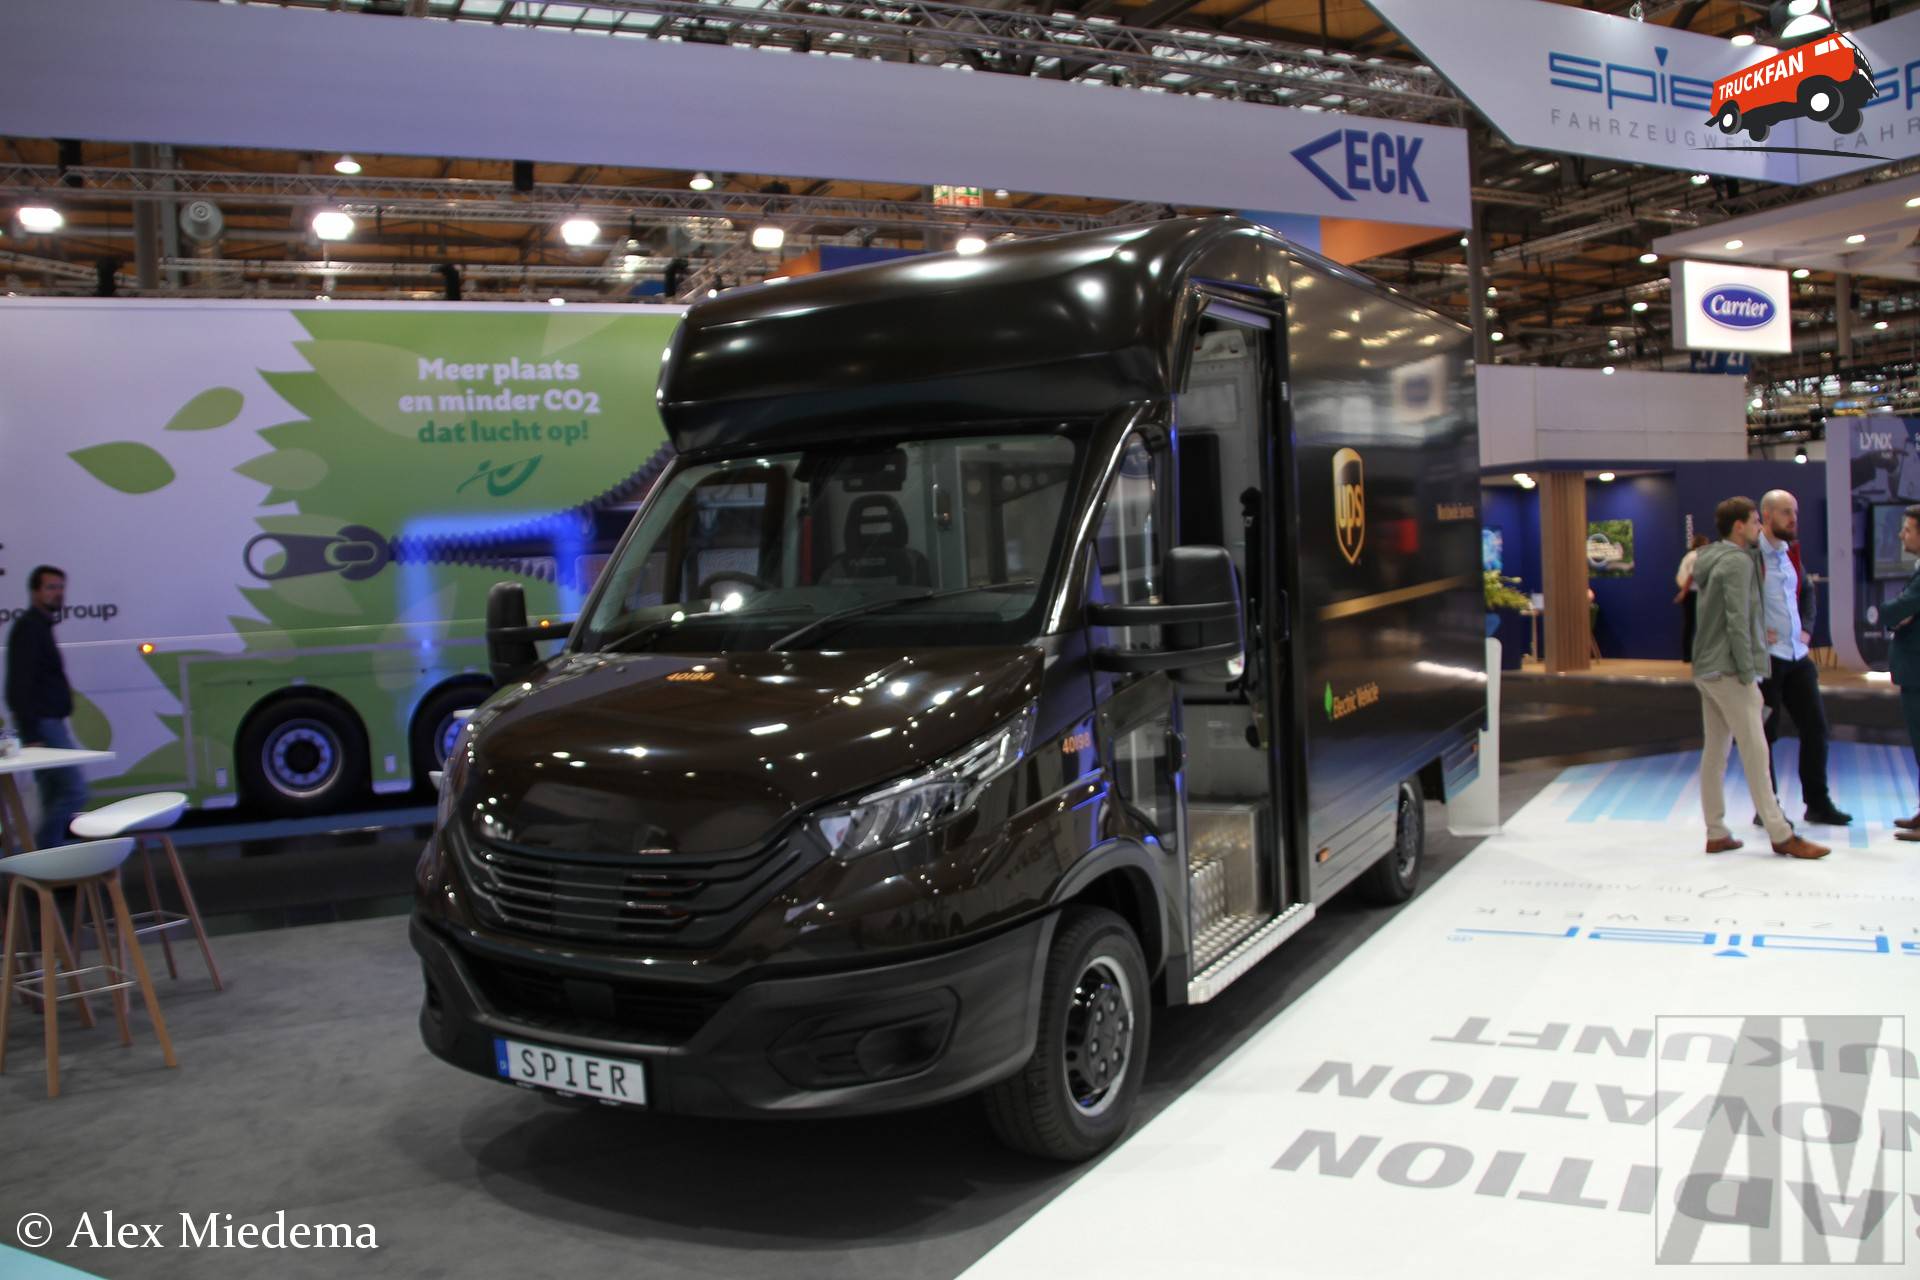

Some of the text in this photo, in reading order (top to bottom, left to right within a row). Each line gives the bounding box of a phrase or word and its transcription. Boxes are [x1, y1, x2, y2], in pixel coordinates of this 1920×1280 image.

[1550, 46, 1714, 112] spie
[1551, 108, 1770, 159] FAHRZEUGWER
[1711, 294, 1769, 318] Carrier
[417, 356, 580, 386] Meer plaats
[399, 387, 601, 414] en minder CO2
[418, 418, 590, 446] dat lucht op!
[1860, 432, 1893, 450] LYNX
[1335, 484, 1362, 545] ups
[1455, 925, 1920, 957] pier
[521, 1049, 627, 1097] SPIER
[1270, 1128, 1920, 1240] ADITION
